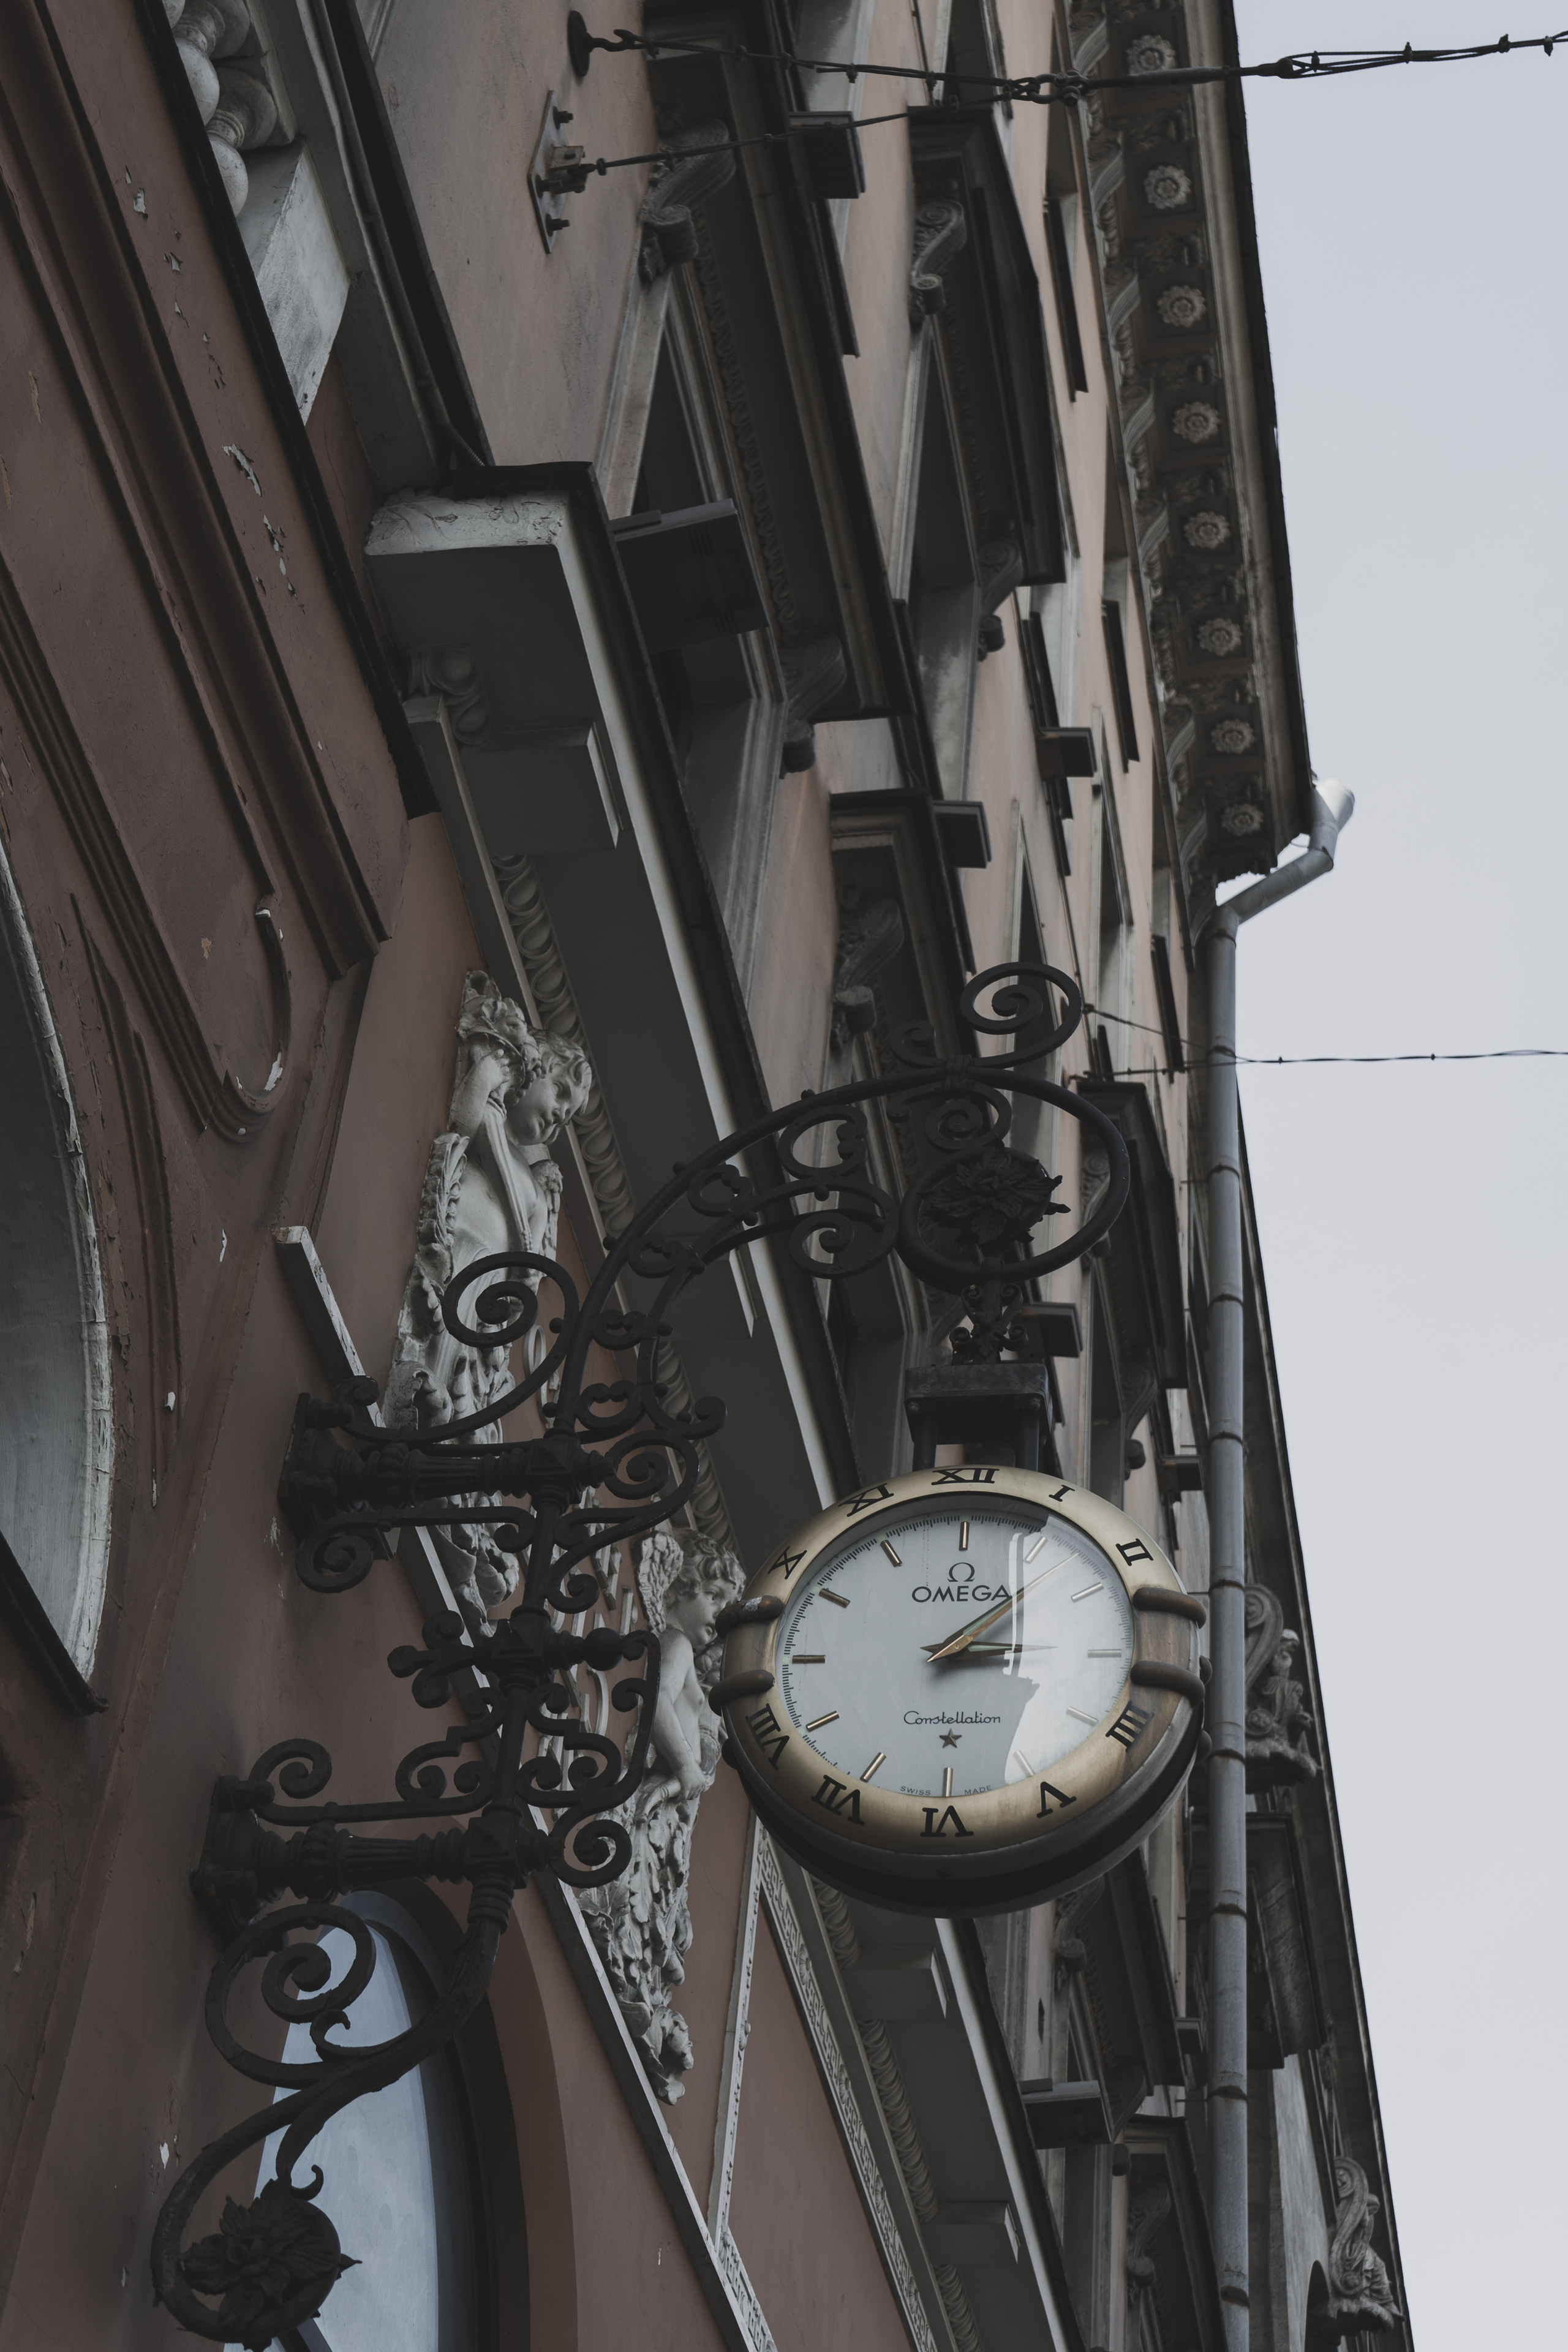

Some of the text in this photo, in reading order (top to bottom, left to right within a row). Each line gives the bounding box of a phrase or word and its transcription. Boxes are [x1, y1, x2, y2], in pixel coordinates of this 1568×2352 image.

[931, 1468, 1000, 1486] XII
[838, 1483, 894, 1517] XI
[1049, 1485, 1076, 1502] I
[767, 1545, 807, 1580] X
[1115, 1538, 1154, 1566] II
[911, 1585, 1011, 1603] OMEGA
[903, 1710, 1001, 1725] Constellation
[900, 1784, 993, 1796] SWISS MADE
[1036, 1781, 1077, 1819] V
[920, 1805, 974, 1838] VI
